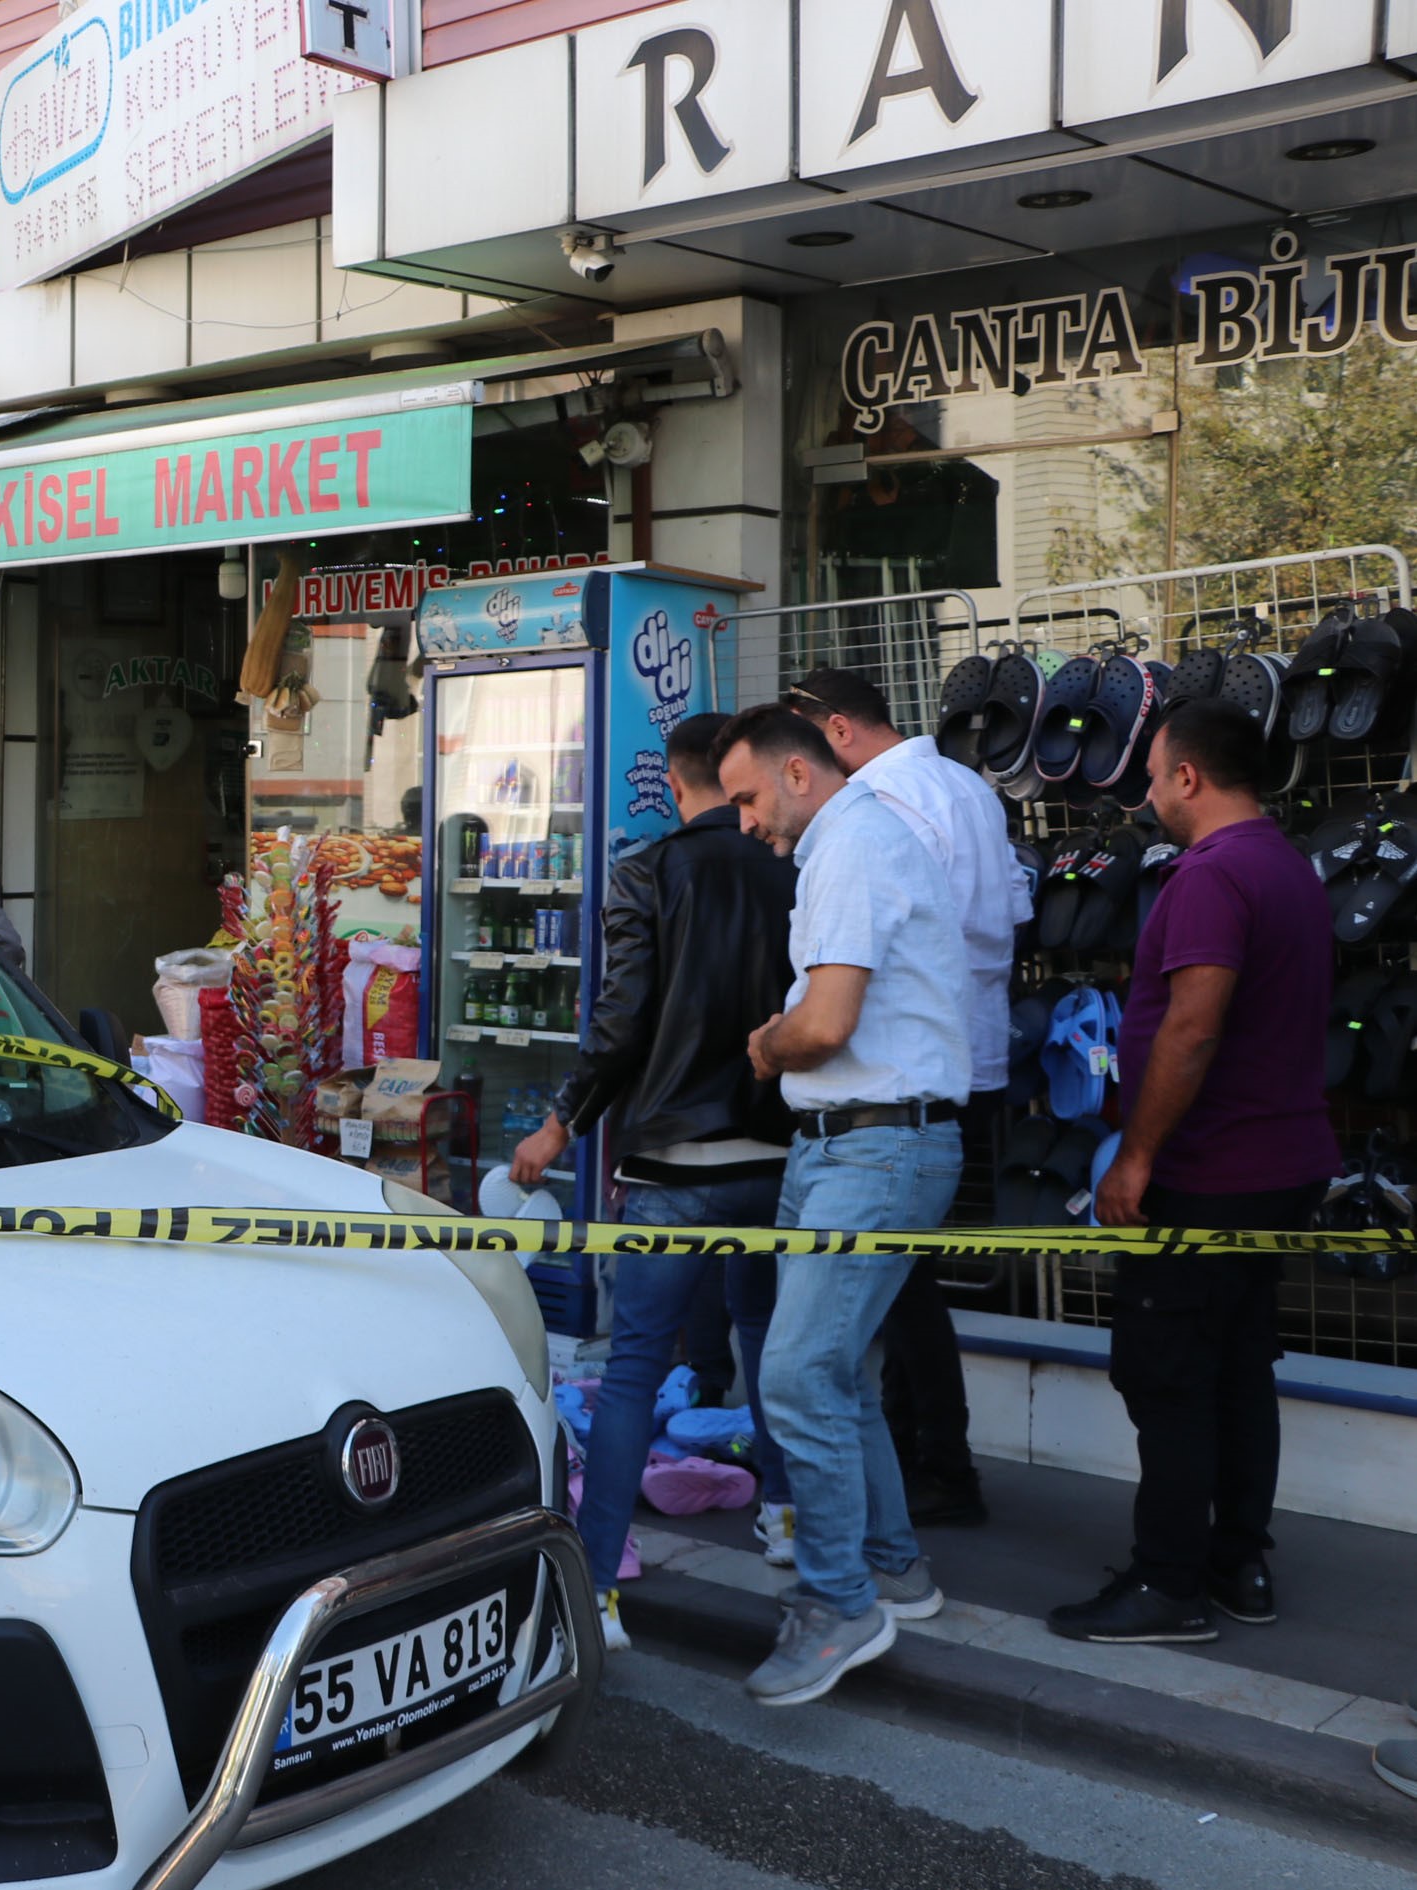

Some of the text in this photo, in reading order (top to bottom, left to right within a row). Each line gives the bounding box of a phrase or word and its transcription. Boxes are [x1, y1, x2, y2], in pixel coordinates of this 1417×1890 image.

[5, 58, 99, 176] HAVZA
[841, 286, 1148, 434] ÇANTA
[154, 429, 382, 528] MARKET
[636, 611, 670, 668] di
[102, 655, 218, 700] AKTAR
[658, 640, 691, 699] di
[649, 698, 686, 724] soğuk
[636, 752, 664, 769] Büyük
[629, 795, 655, 815] Soğuk
[637, 781, 664, 795] Büyük
[357, 1441, 390, 1487] FIAT
[294, 1599, 504, 1735] 55 VA 813
[280, 1716, 290, 1735] R
[397, 1693, 456, 1728] Otomotiv.com
[274, 1749, 313, 1771] Samsun
